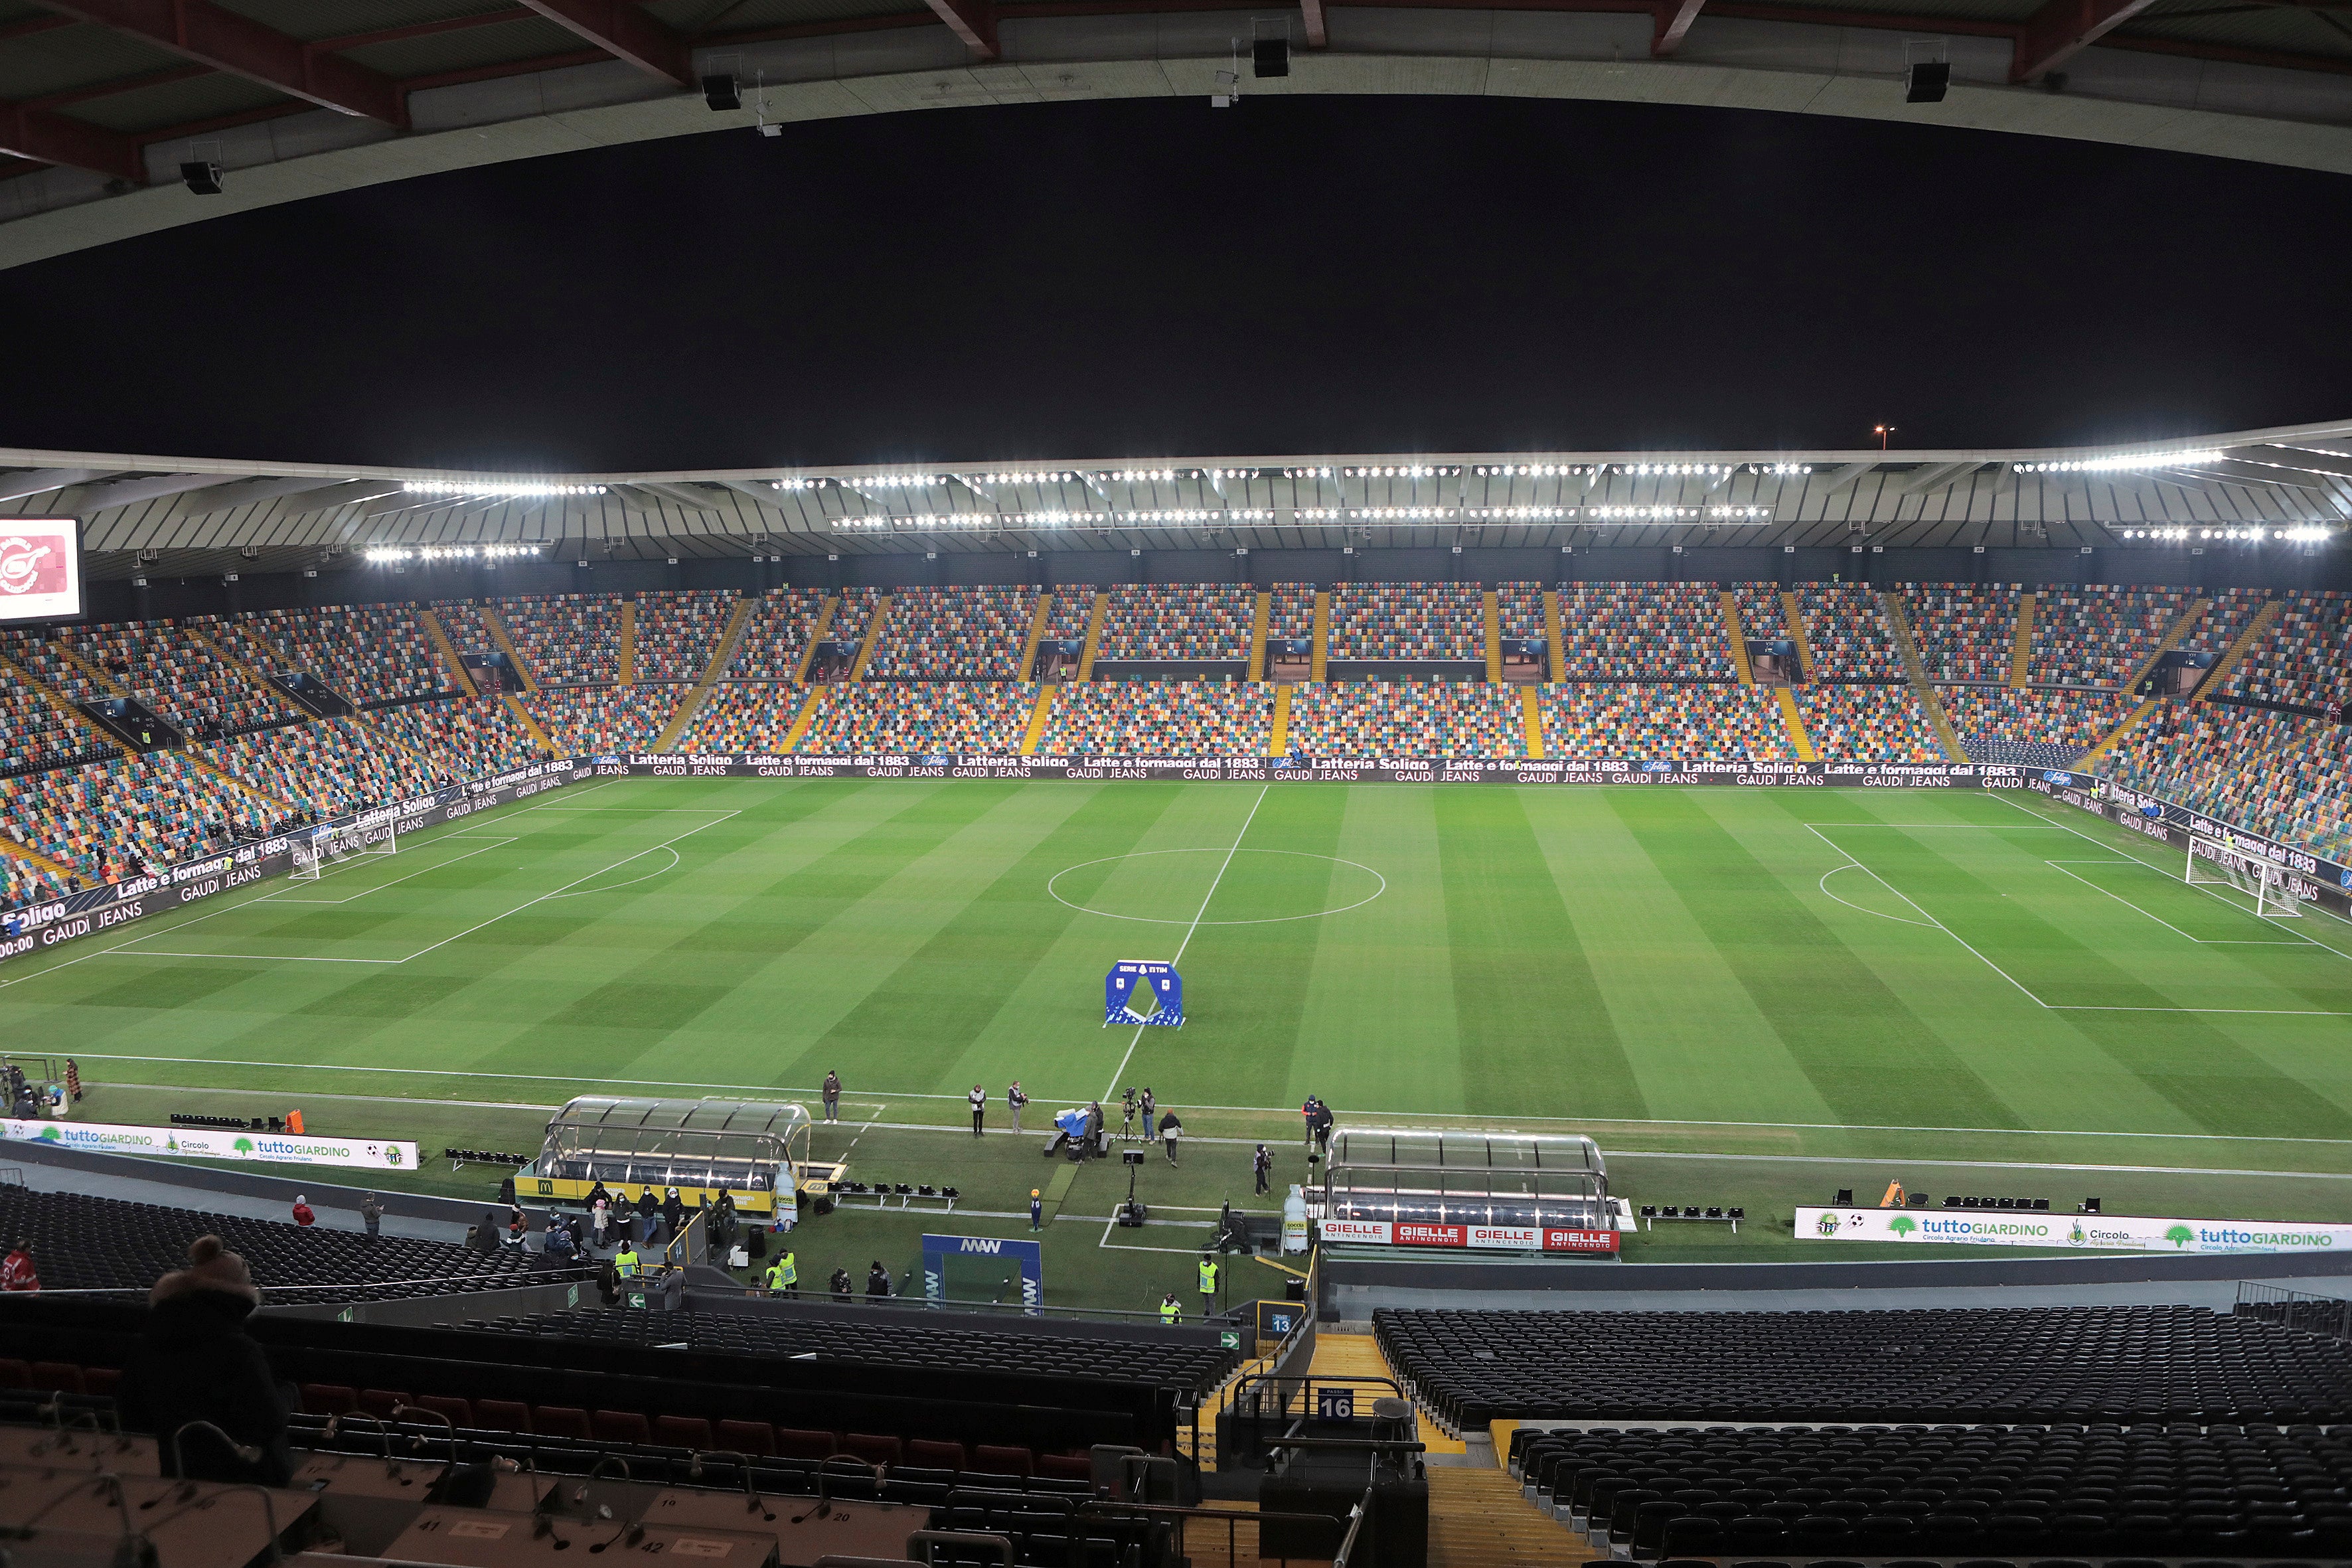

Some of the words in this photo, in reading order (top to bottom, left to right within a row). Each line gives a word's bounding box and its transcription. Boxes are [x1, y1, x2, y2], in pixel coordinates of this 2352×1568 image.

[630, 754, 685, 765] Latteria
[746, 755, 780, 765] Latte
[783, 755, 792, 765] e
[795, 755, 851, 765] formaggi
[854, 755, 874, 766] dal
[878, 755, 909, 766] 1883
[959, 755, 1016, 766] Latteria
[1084, 756, 1119, 767] Latte
[1123, 757, 1133, 767] e
[1135, 757, 1196, 768] formaggi
[1200, 757, 1220, 768] dal
[1225, 757, 1258, 769] 1883
[1312, 758, 1374, 769] Latteria
[1446, 759, 1484, 771] Latte
[1487, 759, 1496, 771] e
[1567, 761, 1589, 772] dal
[1594, 761, 1628, 772] 1883
[596, 763, 629, 775] JEANS
[693, 766, 726, 775] JEANS
[799, 766, 833, 775] JEANS
[909, 767, 944, 776] JEANS
[995, 767, 1030, 777] JEANS
[1683, 761, 1747, 773] Latteria
[1825, 763, 1863, 774] Latte
[1867, 764, 1877, 775] e
[1879, 765, 1946, 775] formaggi
[1950, 765, 1973, 776] dal
[1978, 765, 2016, 777] 1883
[461, 782, 484, 797] Ltte
[485, 779, 491, 790] e
[491, 769, 526, 787] formaggi
[528, 765, 542, 777] dal
[545, 759, 574, 774] 1883
[1110, 769, 1146, 778] JEANS
[1227, 769, 1265, 779] JEANS
[1319, 770, 1357, 780] JEANS
[1441, 771, 1479, 781] JEANS
[1563, 773, 1603, 783] JEANS
[1658, 773, 1697, 783] JEANS
[540, 775, 560, 791] JEANS
[1784, 775, 1823, 785] JEANS
[1910, 776, 1950, 786] JEANS
[2027, 777, 2051, 794] JEANS
[402, 796, 435, 815] Soligo
[474, 794, 497, 812] JEANS
[2083, 799, 2103, 815] JEANS
[397, 816, 424, 835] JEANS
[2144, 821, 2167, 841] JEANS
[329, 835, 359, 855] JEANS
[2190, 815, 2213, 835] Latte
[2215, 827, 2221, 838] e
[2268, 844, 2286, 863] dal
[2288, 850, 2316, 874] 1883
[2218, 850, 2246, 872] JEANS
[118, 877, 158, 898] Latte
[161, 875, 171, 886] e
[236, 842, 254, 863] dal
[258, 837, 288, 856] 1883
[226, 865, 262, 888] JEANS
[2286, 876, 2318, 901] JEANS
[98, 902, 143, 929] JEANS
[64, 1129, 152, 1145] tuttoGIARDINO
[181, 1140, 209, 1149] Circolo
[258, 1140, 350, 1157] tuttoGIARDINO
[1325, 1223, 1383, 1234] GIELLE
[1399, 1226, 1458, 1237] GIELLE
[1922, 1219, 2048, 1236] tuttoGIARDINO
[1475, 1230, 1533, 1240] GIELLE
[1551, 1232, 1610, 1243] GIELLE
[2090, 1230, 2129, 1240] Circolo
[2199, 1228, 2332, 1246] tuttoGIARDINO
[1274, 1320, 1289, 1332] 13
[1321, 1398, 1350, 1417] 16
[833, 1513, 850, 1522] 20
[641, 1541, 663, 1553] 42
